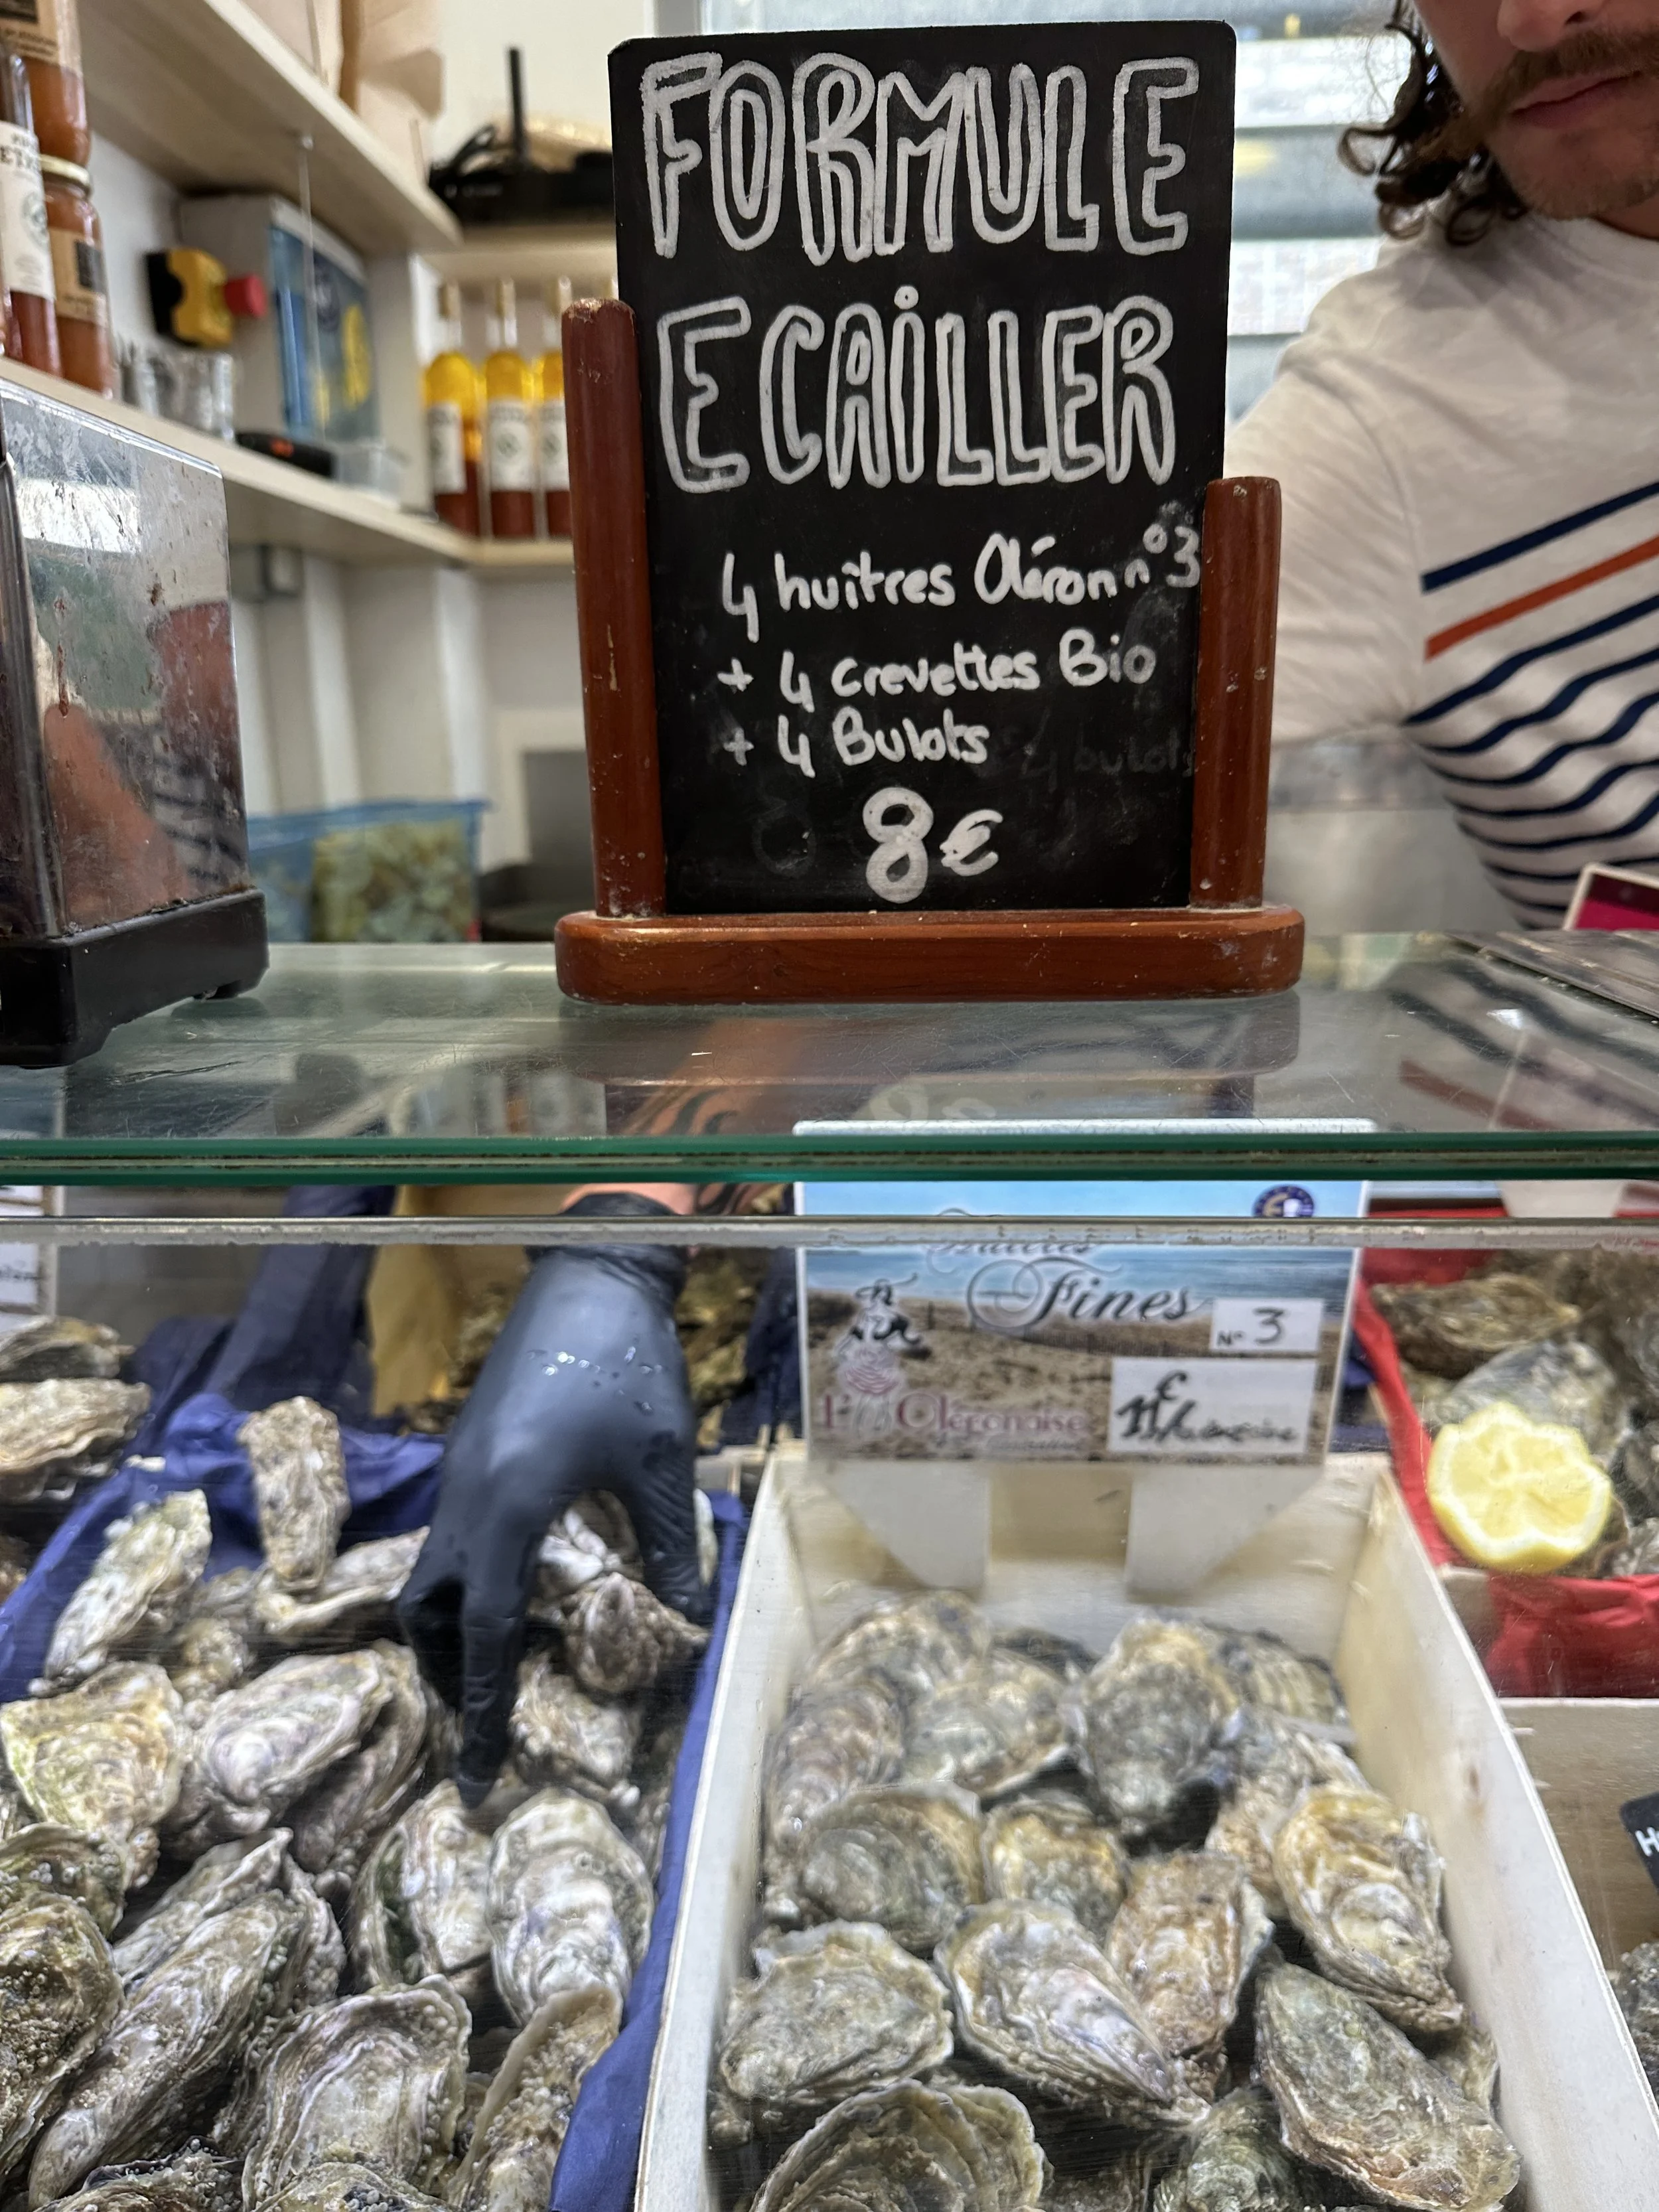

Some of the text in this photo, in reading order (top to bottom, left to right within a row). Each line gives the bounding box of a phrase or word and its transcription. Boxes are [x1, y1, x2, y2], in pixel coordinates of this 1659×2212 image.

[642, 52, 1198, 265] FORMULE
[723, 552, 759, 642] 4
[779, 650, 815, 712] 4
[1059, 628, 1156, 686] Bio
[777, 715, 816, 778] 4
[832, 706, 990, 767] Bulots
[967, 1256, 1213, 1330] Fines
[1253, 1307, 1286, 1345] 3
[1634, 1826, 1659, 1857] H
